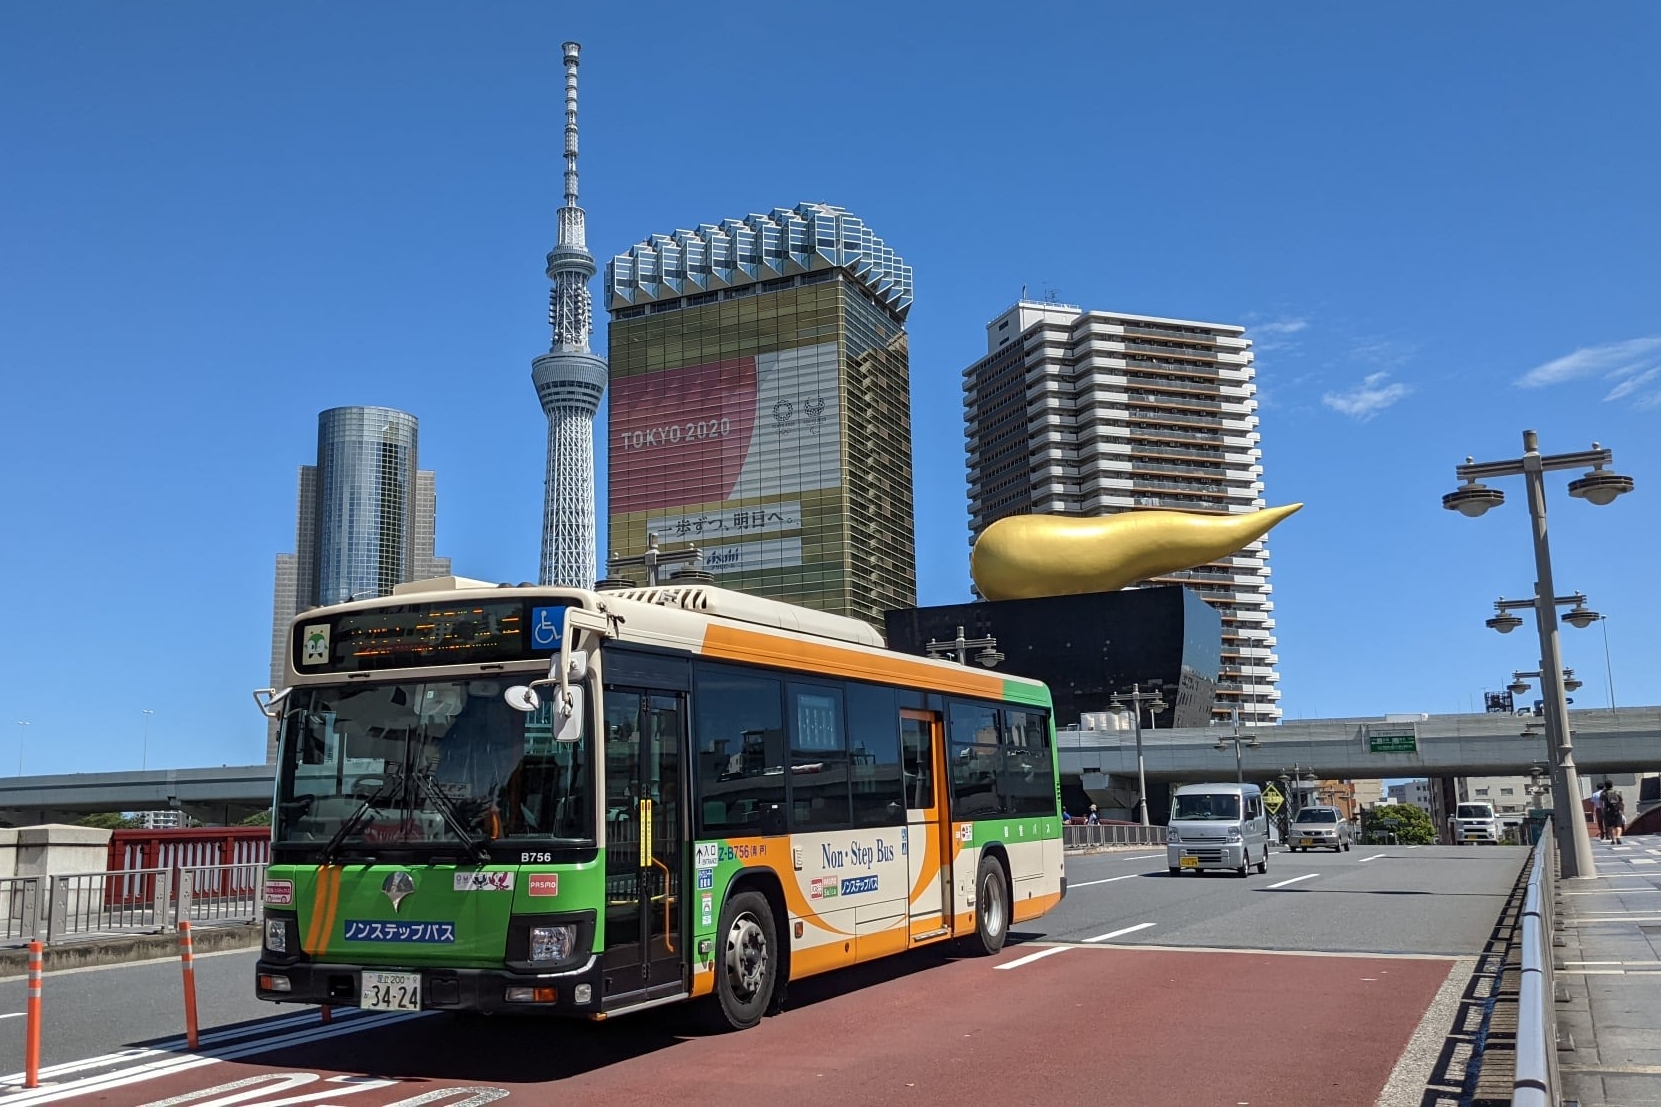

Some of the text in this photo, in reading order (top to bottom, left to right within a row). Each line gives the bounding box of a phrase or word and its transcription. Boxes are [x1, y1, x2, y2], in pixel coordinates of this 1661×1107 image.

[621, 417, 731, 450] TOKYO 2020
[657, 510, 794, 538] 一歩ずつ、明日へ。
[521, 852, 552, 862] B756
[703, 845, 717, 857] 入口
[876, 839, 894, 863] Bus
[530, 881, 556, 889] PASMO
[841, 877, 878, 894] ノンステップバス
[345, 922, 454, 941] ノンステップバス
[371, 984, 418, 1009] 34-24
